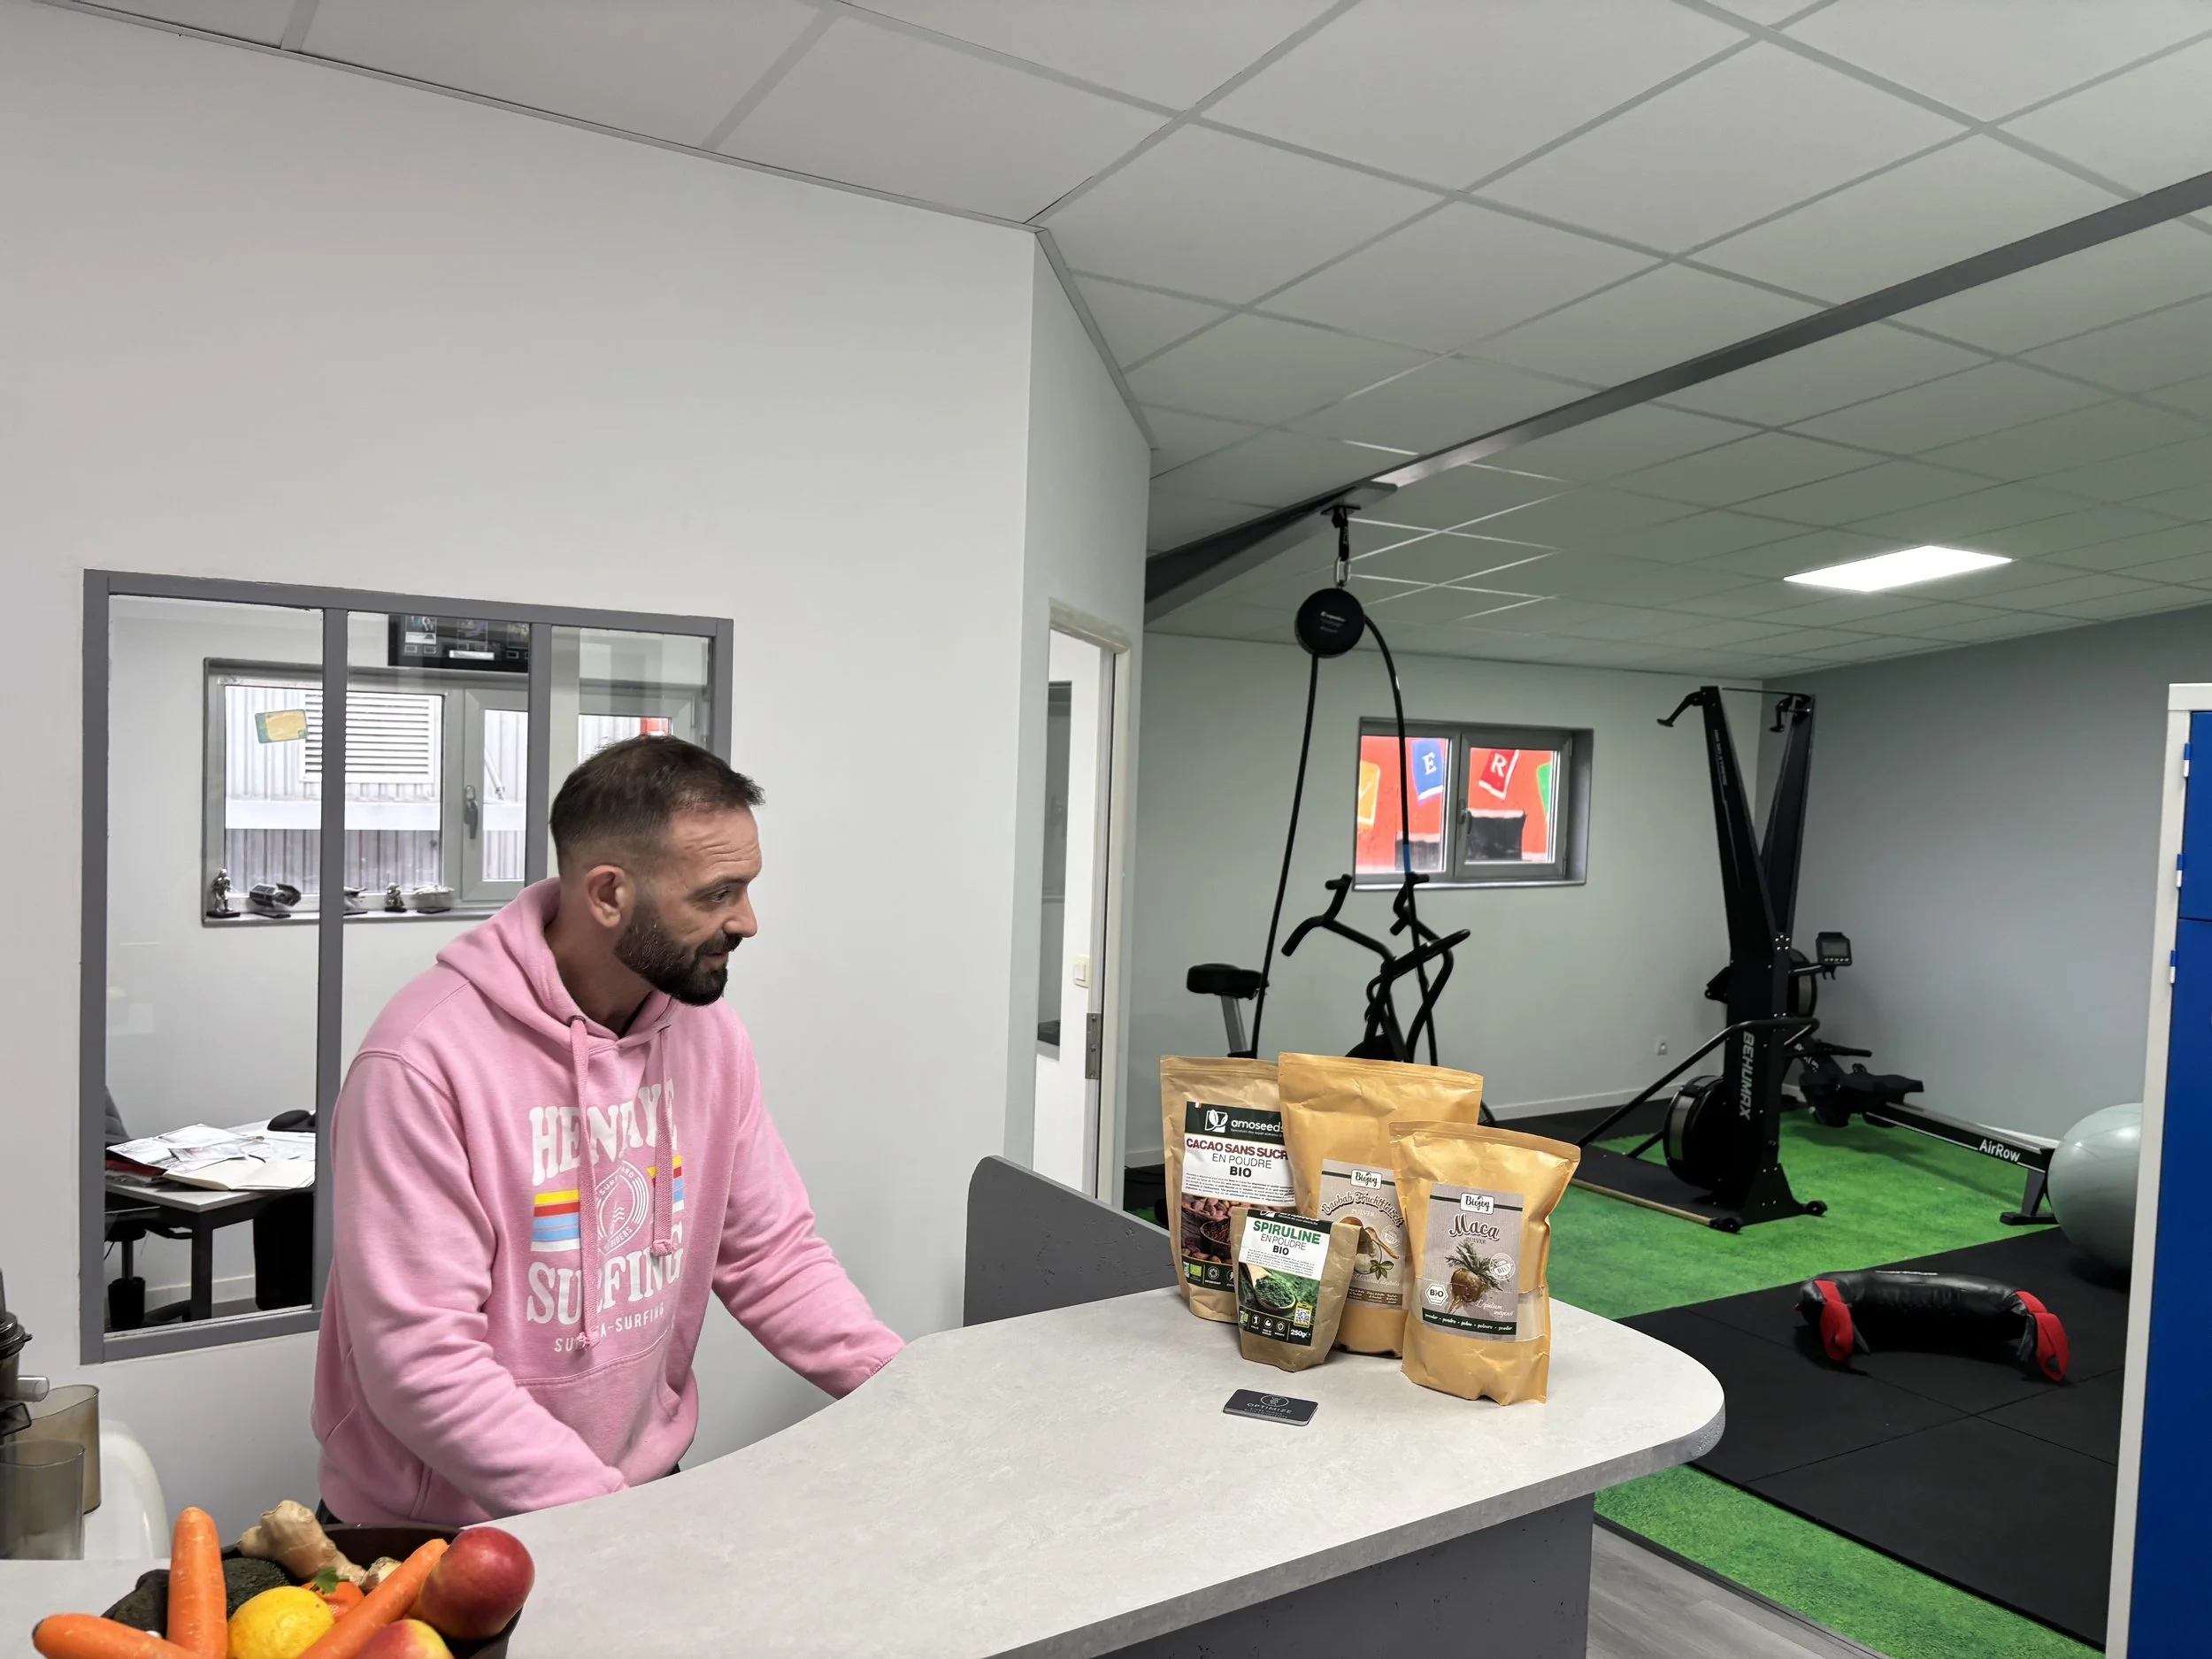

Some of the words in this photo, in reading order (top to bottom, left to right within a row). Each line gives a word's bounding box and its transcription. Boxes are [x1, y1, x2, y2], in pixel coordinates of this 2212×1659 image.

[1422, 751, 1437, 775] E
[1491, 753, 1507, 778] R
[1740, 1031, 1755, 1121] BEHUMAX
[1187, 1138, 1223, 1152] CACAO
[1225, 1143, 1256, 1156] SANS
[1979, 1139, 2021, 1162] AirRow
[1212, 1153, 1226, 1163] EN
[1228, 1155, 1271, 1169] POUDRE
[1230, 1166, 1252, 1178] BIO
[1322, 1192, 1354, 1216] Baobab
[1253, 1220, 1321, 1245] SPIRULINE
[1448, 1213, 1500, 1241] Maca
[1260, 1233, 1271, 1243] EN
[1272, 1236, 1307, 1250] POUDRE
[1272, 1245, 1289, 1256] BIO
[526, 1221, 683, 1325] SUFING
[1497, 1265, 1509, 1274] BIO
[1247, 1402, 1292, 1414] OPTIMIZE
